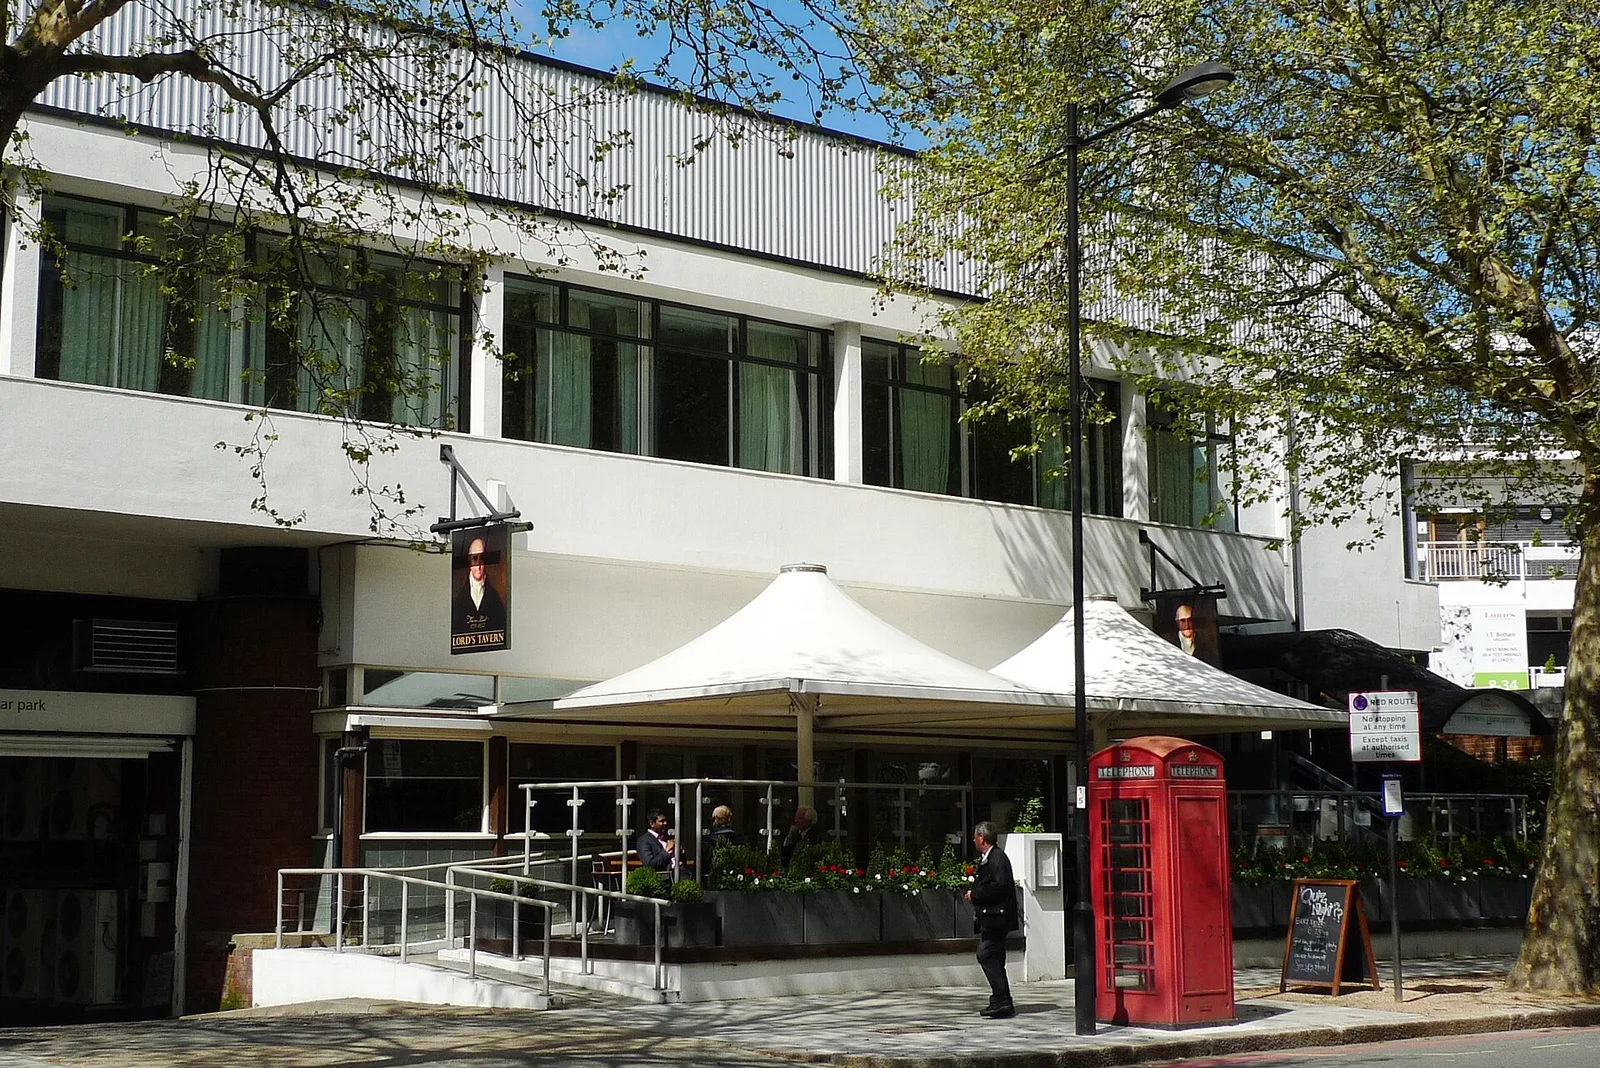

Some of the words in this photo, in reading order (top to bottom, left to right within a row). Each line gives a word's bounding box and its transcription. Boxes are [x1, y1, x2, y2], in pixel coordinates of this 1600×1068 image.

[452, 636, 476, 646] LORD'S
[477, 632, 504, 644] TAVERN
[17, 699, 46, 713] park
[1388, 698, 1417, 706] ROUTE
[1375, 715, 1407, 723] stopping
[1362, 736, 1388, 744] Except
[1371, 743, 1409, 751] authorised
[1101, 766, 1154, 777] TELEPHONE
[1172, 767, 1216, 777] TELEPHONE
[1300, 887, 1328, 906] Quiz
